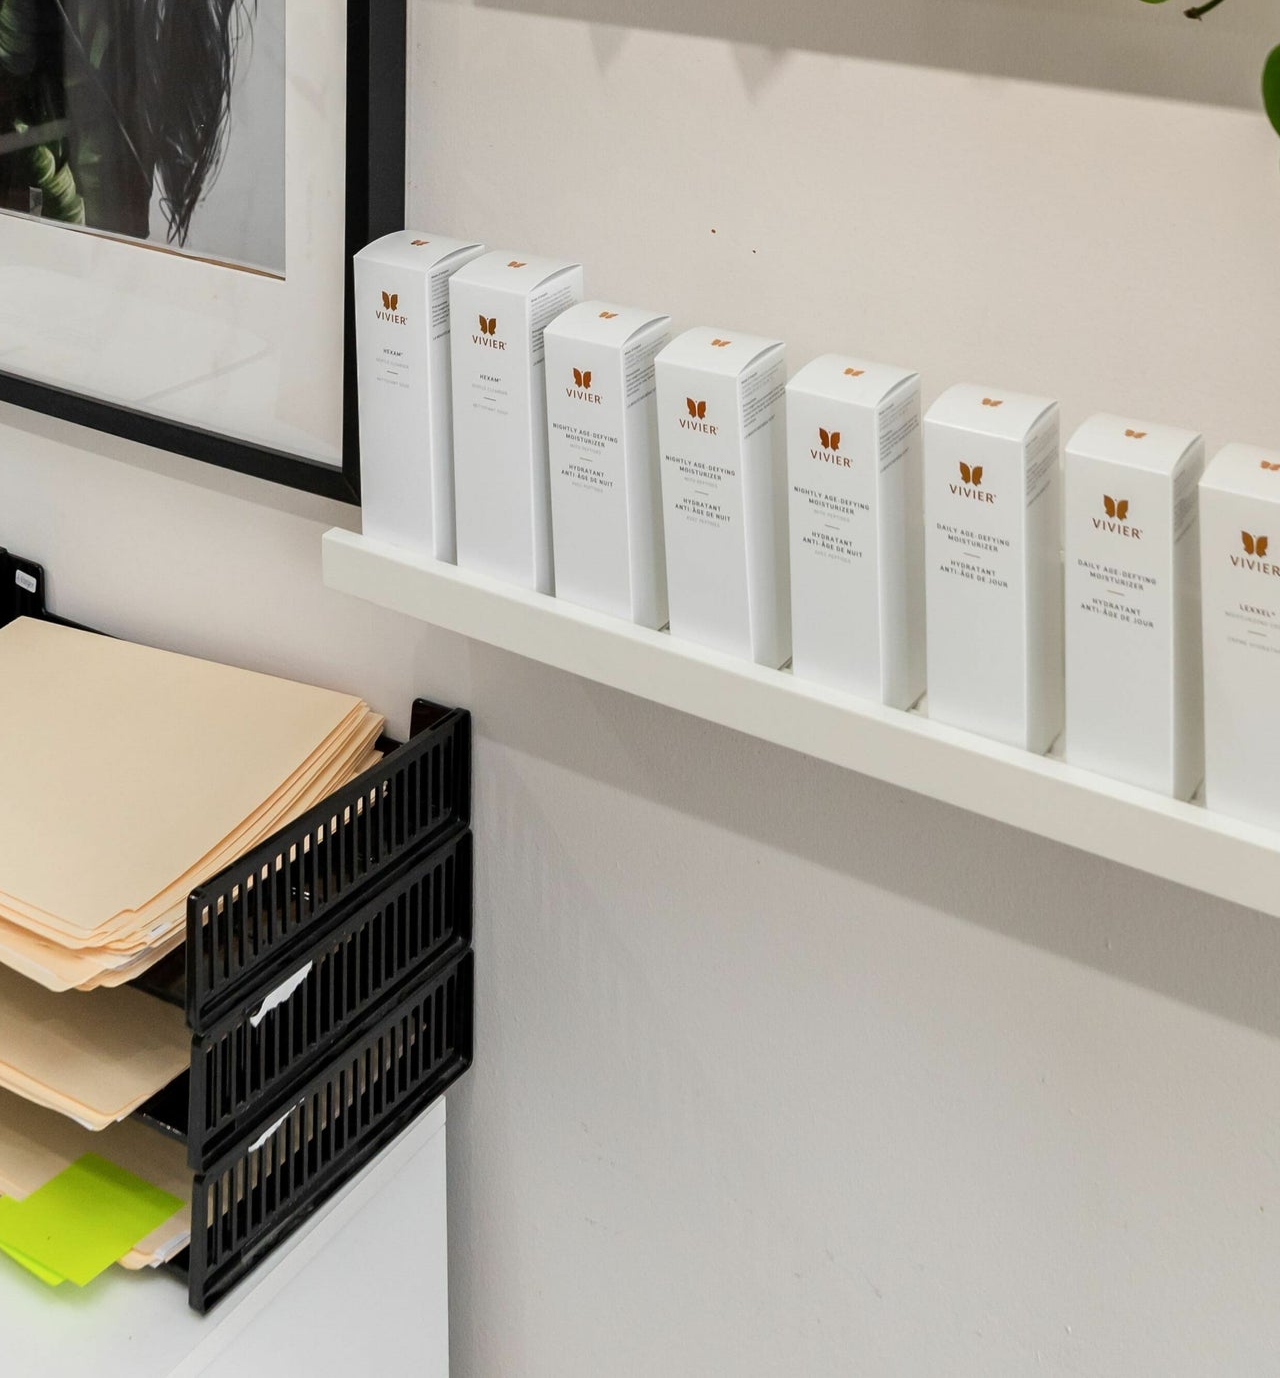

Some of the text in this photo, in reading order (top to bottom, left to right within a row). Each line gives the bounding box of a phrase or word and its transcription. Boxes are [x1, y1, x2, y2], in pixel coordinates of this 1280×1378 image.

[375, 311, 407, 325] VIVIER
[472, 335, 506, 350] VIVIER
[566, 388, 601, 404] VIVIER
[553, 423, 576, 434] NIGHTLY
[679, 419, 717, 435] VIVIER
[565, 433, 605, 447] MOISTURIZER
[665, 455, 691, 466] NIGHTLY
[810, 450, 851, 467] VIVIER
[569, 464, 604, 478] HYDRATANT
[679, 465, 721, 480] MOISTURIZER
[598, 478, 613, 487] NUIT
[794, 486, 821, 498] NIGHTLY
[949, 485, 994, 503] VIVIER
[683, 498, 721, 512] HYDRATANT
[808, 498, 854, 515] MOISTURIZER
[705, 510, 713, 518] DE
[715, 513, 731, 522] NUIT
[937, 524, 957, 534] DAILY
[1092, 518, 1141, 539] VIVIER
[811, 531, 852, 547] HYDRATANT
[948, 535, 998, 551] MOISTURIZER
[835, 544, 844, 552] DE
[846, 547, 863, 557] NUIT
[950, 560, 995, 577] HYDRATANT
[1078, 559, 1100, 571] DAILY
[1230, 556, 1280, 577] VIVIER
[976, 574, 986, 583] DE
[988, 577, 1008, 588] JOUR
[1090, 571, 1144, 590] MOISTURIZER
[1092, 598, 1141, 616] HYDRATANT
[1120, 612, 1130, 622] DE
[1133, 616, 1154, 628] JOUR
